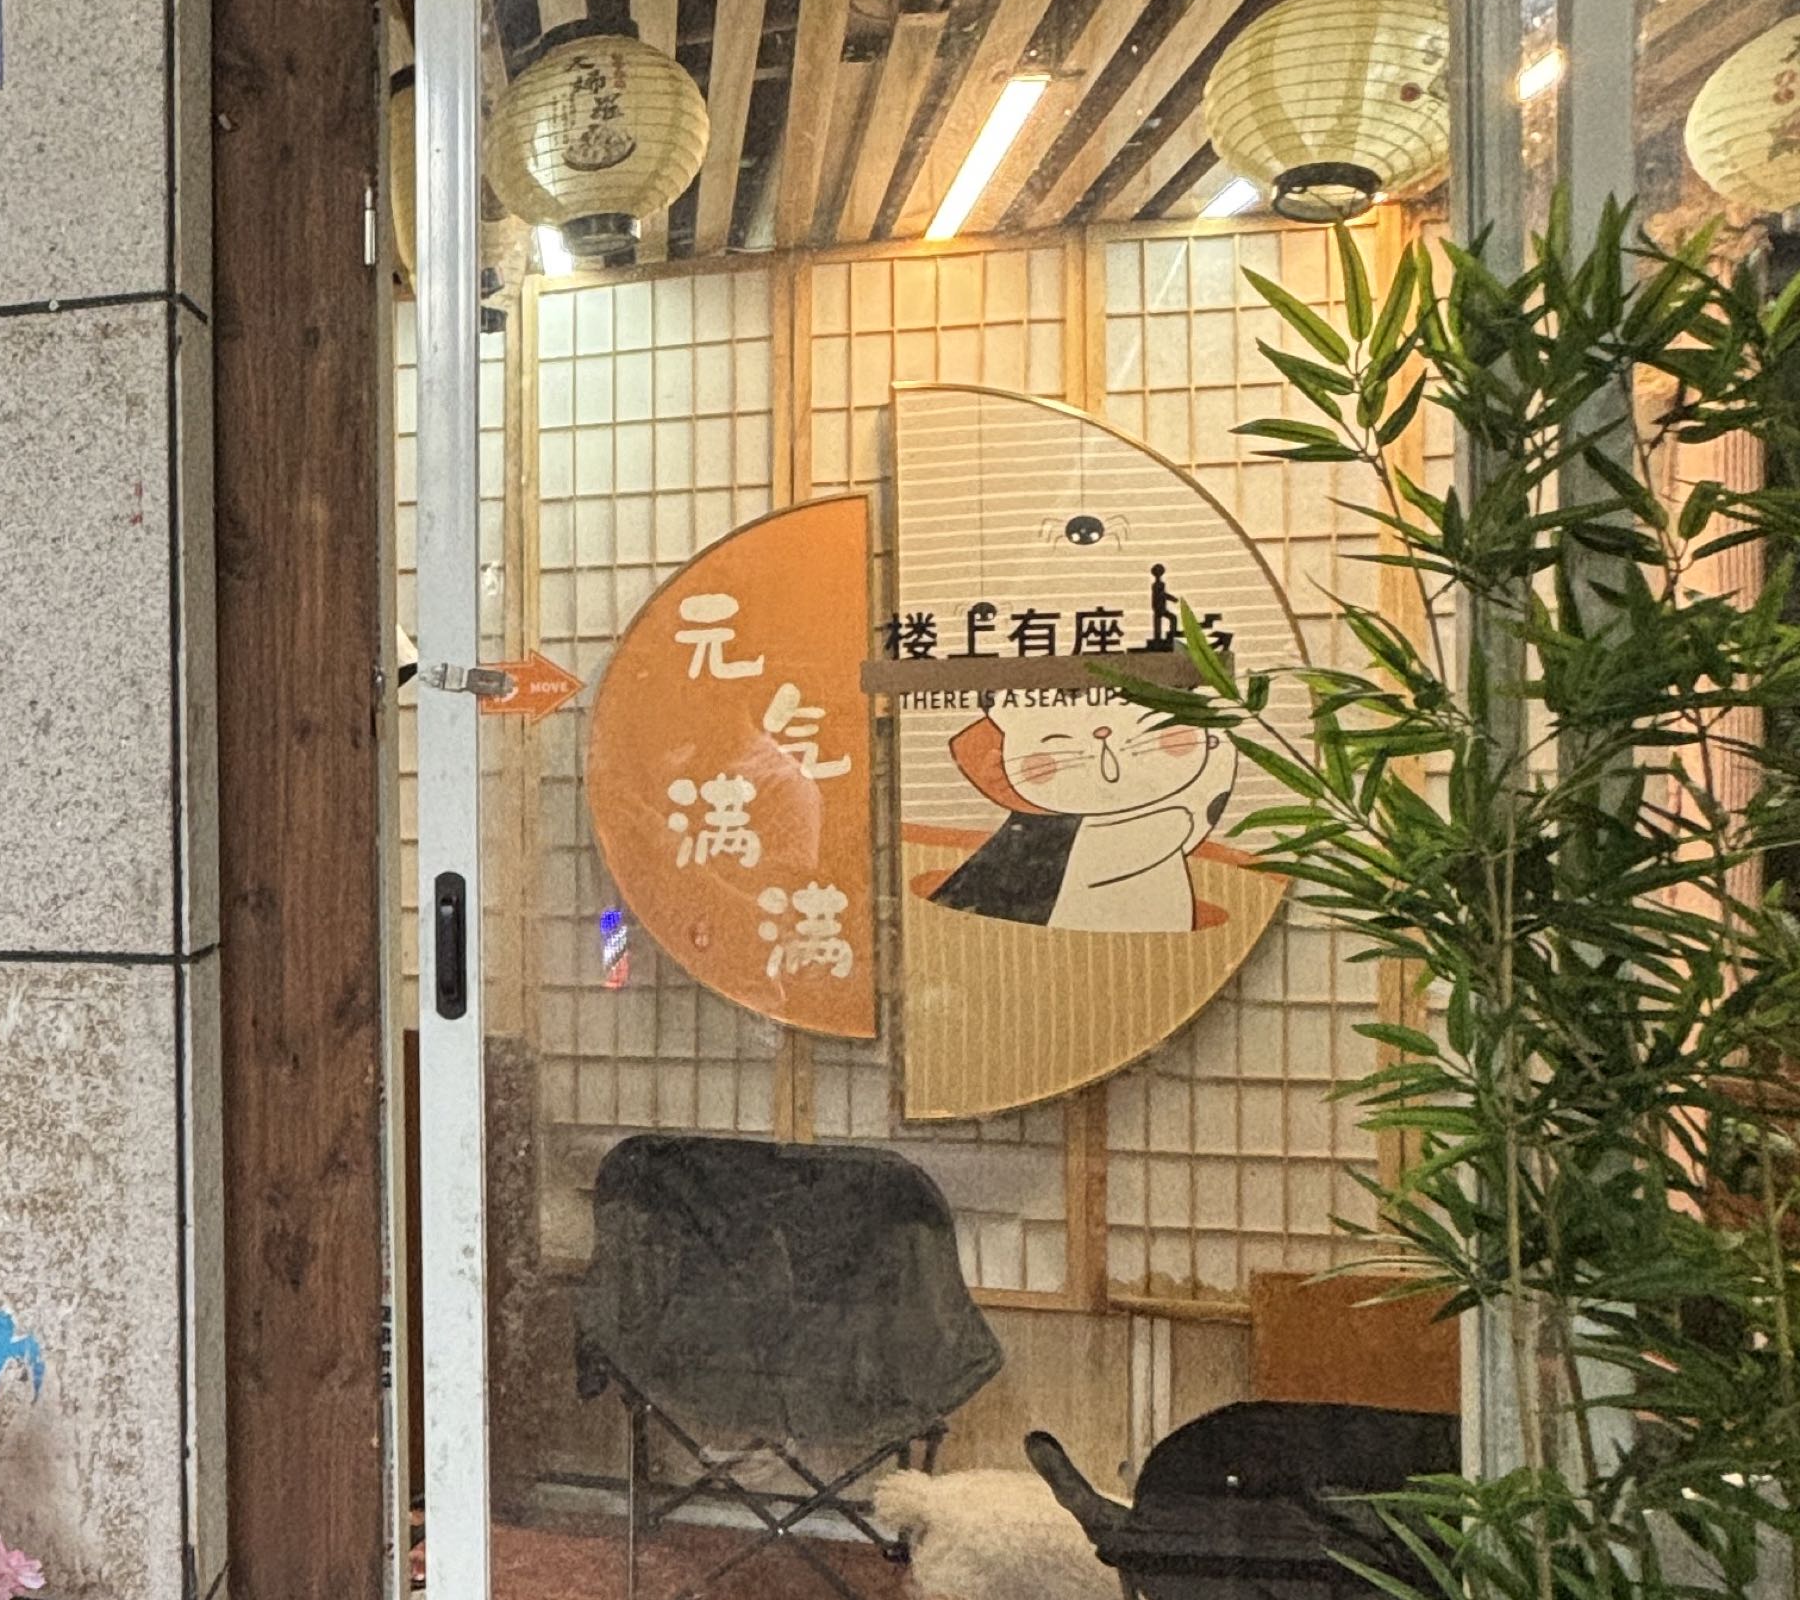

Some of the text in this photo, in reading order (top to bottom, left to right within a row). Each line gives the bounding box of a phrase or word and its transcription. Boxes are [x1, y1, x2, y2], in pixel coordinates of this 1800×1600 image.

[884, 606, 1125, 660] 楼上有座
[530, 681, 569, 693] MOVE
[903, 690, 971, 710] THERE
